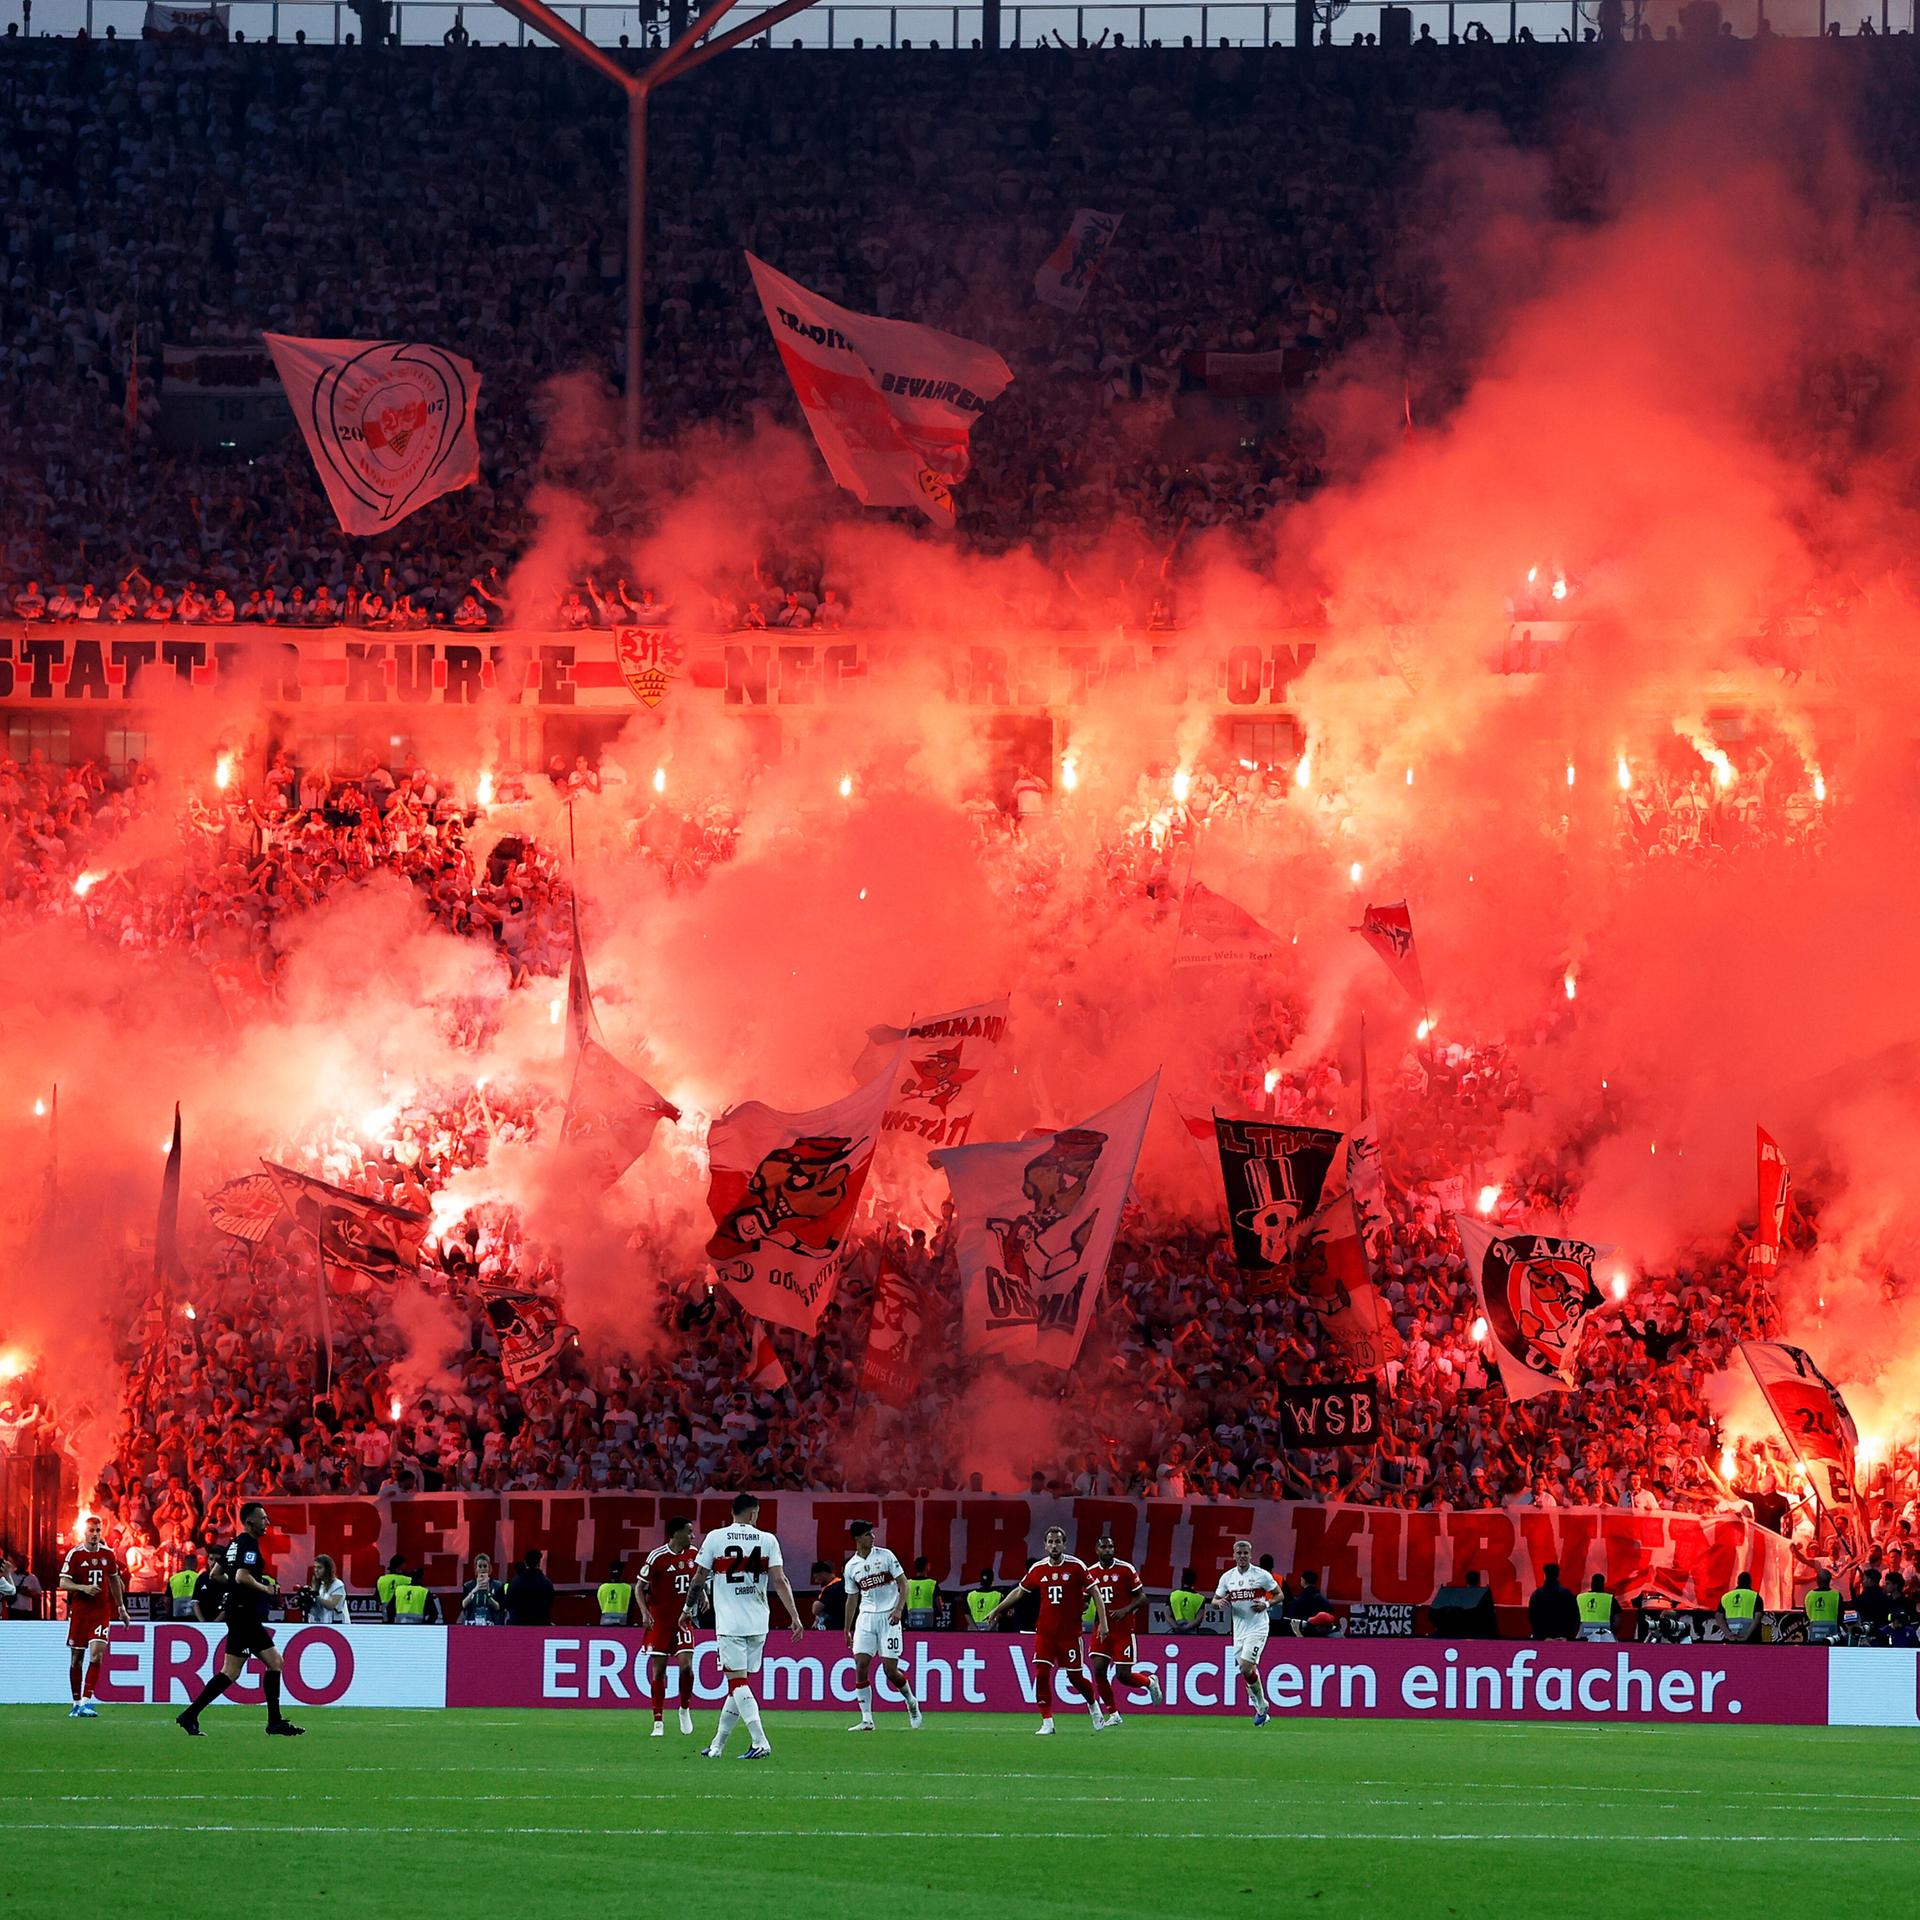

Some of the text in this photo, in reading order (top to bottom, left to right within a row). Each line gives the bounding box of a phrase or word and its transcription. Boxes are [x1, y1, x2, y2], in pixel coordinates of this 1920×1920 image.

[1284, 1393, 1372, 1435] WSB
[726, 1532, 760, 1541] STUTTGART
[1073, 1500, 1256, 1590] DIE
[724, 1545, 762, 1584] 24
[735, 1586, 757, 1596] CHABOT
[1368, 1605, 1414, 1619] MAGIC
[1368, 1620, 1413, 1635] FANS
[676, 1630, 692, 1645] 10
[887, 1637, 899, 1650] 30
[1068, 1649, 1077, 1662] 9
[1123, 1645, 1131, 1658] 4
[93, 1623, 355, 1705] ERGO
[542, 1638, 730, 1701] ERGO
[763, 1641, 986, 1703] macht
[1401, 1648, 1742, 1715] einfacher.
